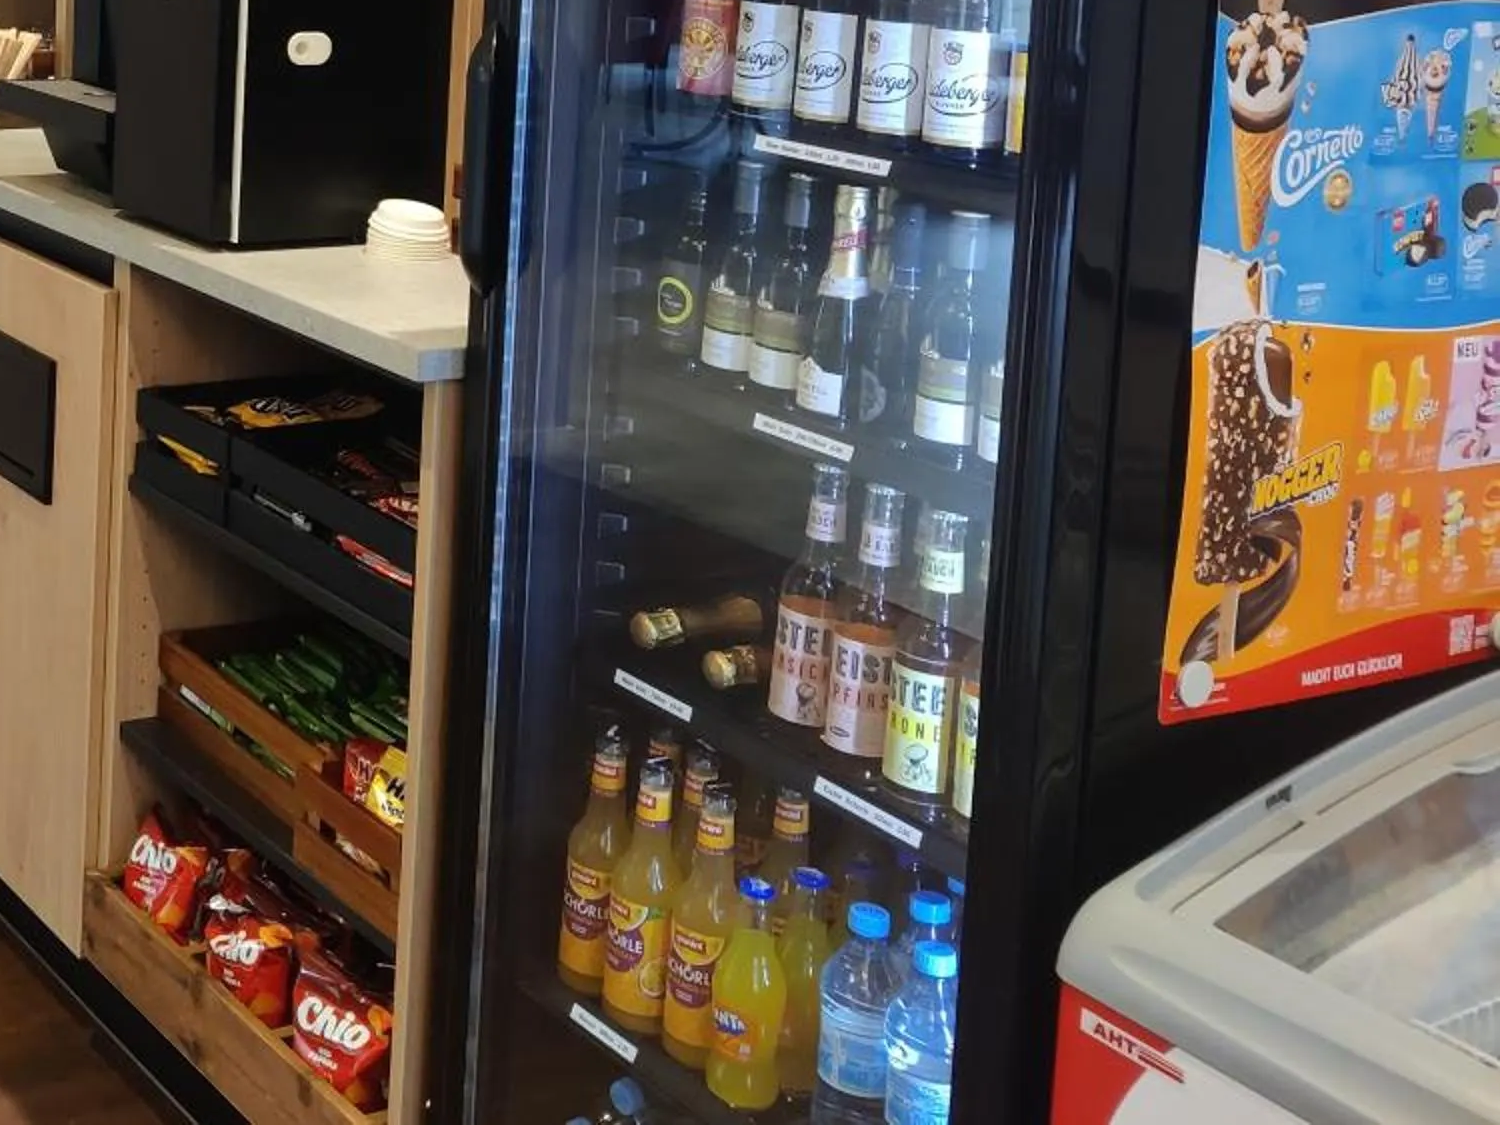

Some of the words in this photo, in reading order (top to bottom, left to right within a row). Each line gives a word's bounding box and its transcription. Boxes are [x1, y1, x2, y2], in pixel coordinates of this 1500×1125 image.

[1272, 125, 1364, 208] Cornetto
[1457, 341, 1479, 357] NEU
[1252, 444, 1341, 513] NOGGER
[131, 834, 177, 874] Chio
[297, 995, 371, 1049] Chio
[1094, 1022, 1137, 1053] AHT
